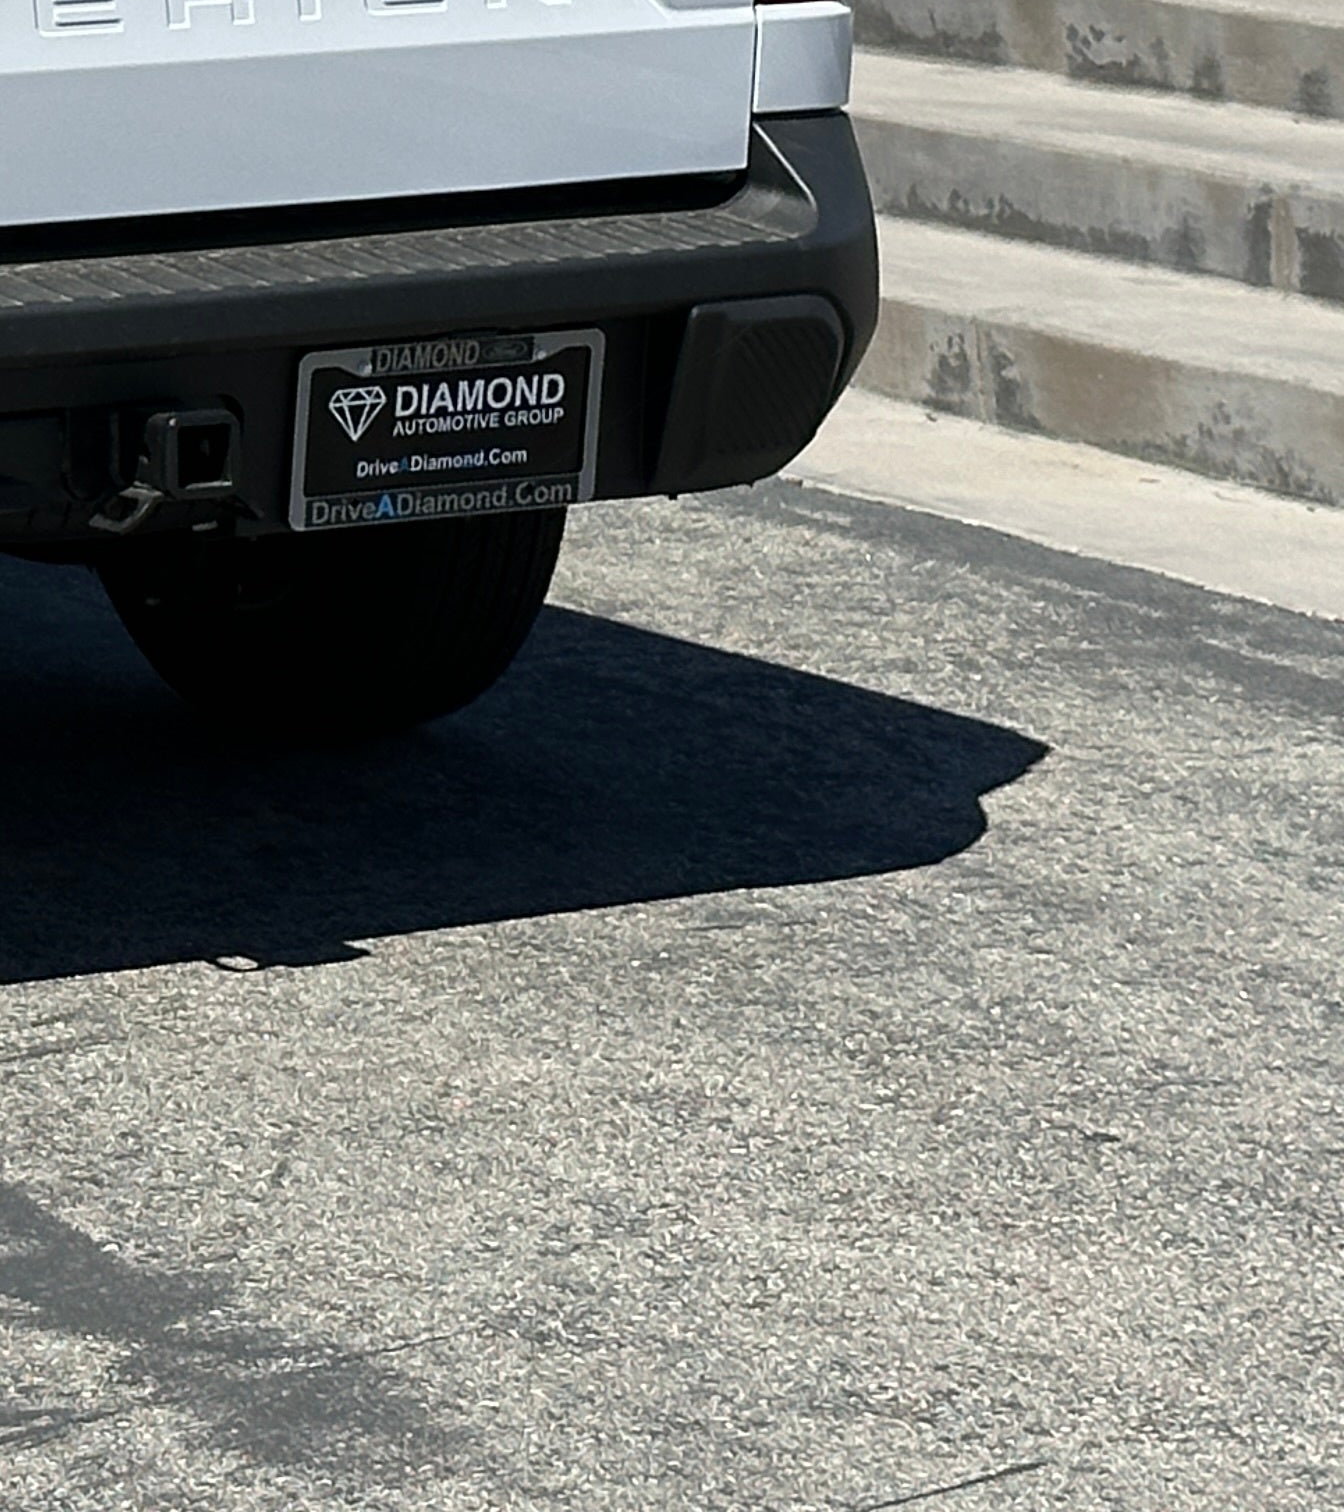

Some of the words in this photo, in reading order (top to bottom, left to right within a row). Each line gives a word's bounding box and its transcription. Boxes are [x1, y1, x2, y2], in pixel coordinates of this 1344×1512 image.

[376, 340, 481, 372] DIAMOND
[394, 373, 565, 418] DIAMOND
[392, 412, 501, 437] AUTOMOTIVE
[503, 407, 564, 427] GROUP
[356, 447, 528, 478] DriveADiamond.Com
[312, 481, 572, 525] DriveADiamond.Com
